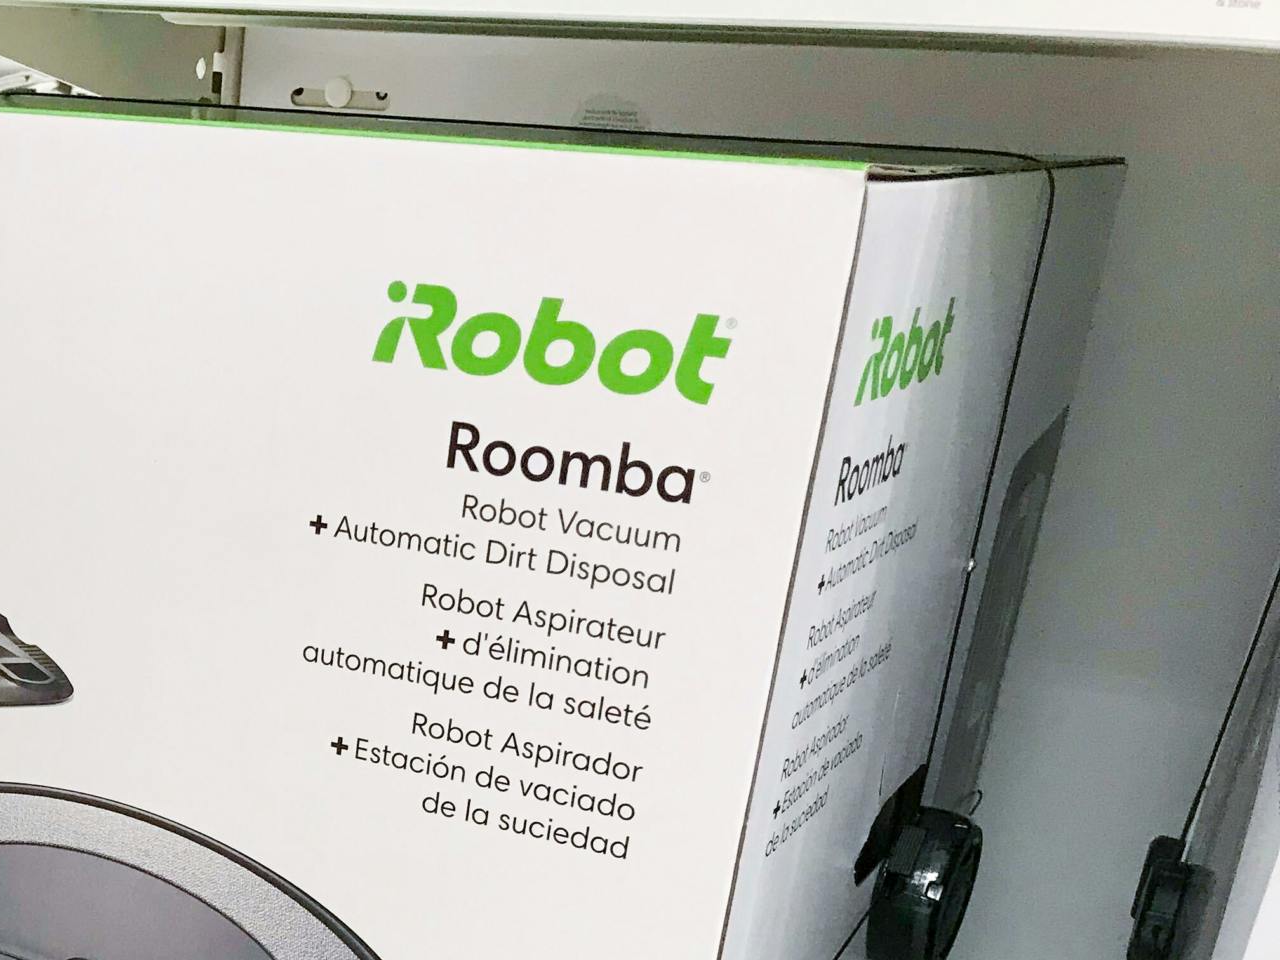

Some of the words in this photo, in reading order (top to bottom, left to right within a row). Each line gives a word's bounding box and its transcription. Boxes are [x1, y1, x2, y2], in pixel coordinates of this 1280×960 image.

[372, 280, 732, 405] iRobot
[446, 421, 696, 504] Roomba
[834, 434, 906, 506] Roomba
[333, 516, 476, 562] Automatic
[486, 540, 536, 572] Dirt
[546, 550, 676, 595] Disposal
[462, 494, 548, 531] Robot
[558, 508, 682, 552] Vacuum
[825, 521, 854, 554] Robot
[854, 506, 888, 537] Vacuum
[825, 547, 869, 591] Automatic
[885, 515, 919, 555] Disposal
[421, 584, 505, 620] Robot
[512, 601, 667, 650] Aspirateur
[807, 614, 834, 650] Robot
[834, 590, 877, 632] Aspirateur
[303, 642, 475, 695] automatique
[483, 676, 519, 703] de
[528, 682, 554, 710] la
[563, 695, 652, 730] saleté
[463, 632, 650, 688] d'élimination
[792, 676, 846, 729] automatique
[355, 738, 466, 783] Estación
[475, 766, 511, 793] de
[519, 779, 636, 821] vaciado
[411, 712, 493, 751] Robot
[500, 732, 643, 783] Aspirador
[781, 744, 809, 782] Robot
[809, 713, 849, 757] Aspirador
[422, 792, 456, 818] de
[465, 799, 490, 826] la
[498, 813, 630, 860] suciedad
[765, 832, 779, 857] de
